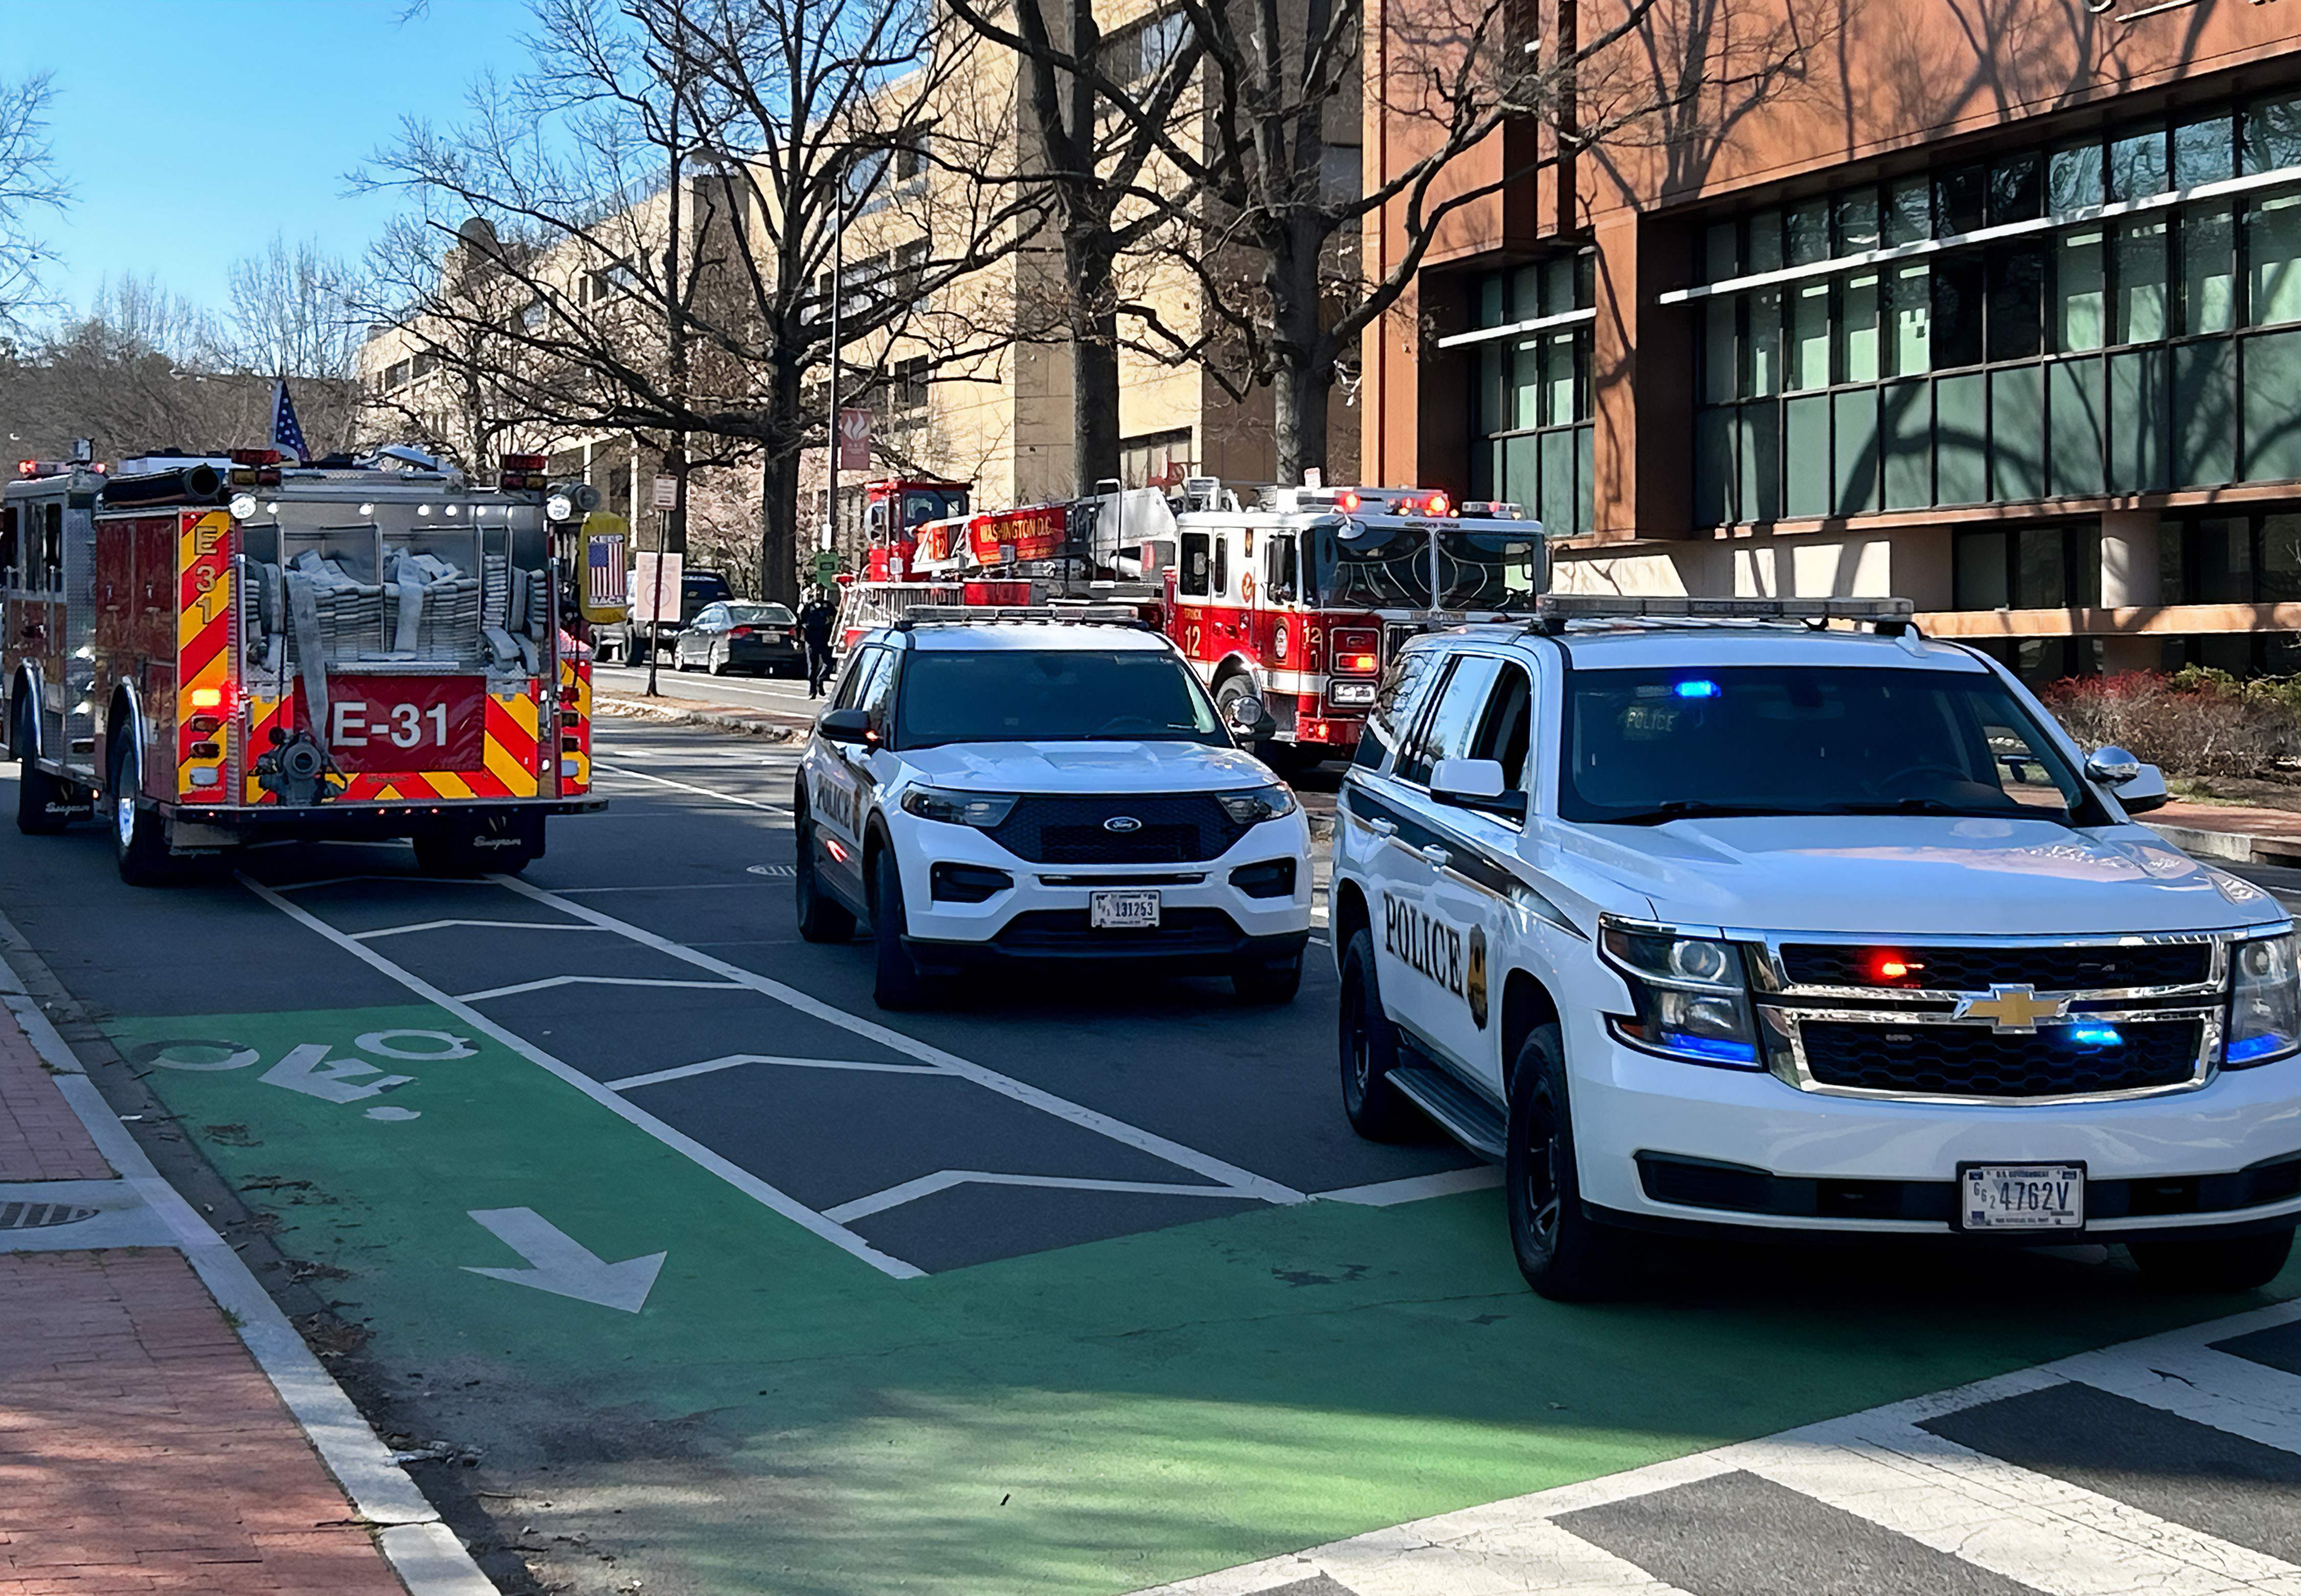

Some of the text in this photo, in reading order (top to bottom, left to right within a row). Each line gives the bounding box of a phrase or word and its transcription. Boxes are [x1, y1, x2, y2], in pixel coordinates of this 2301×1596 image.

[589, 535, 624, 543] KEEP
[589, 596, 624, 605] BACK
[1185, 625, 1201, 657] 12
[1303, 626, 1322, 644] 12
[332, 702, 446, 748] E-31
[1626, 711, 1675, 732] POLICE
[816, 773, 851, 829] POLICE
[1383, 890, 1465, 1000] POLICE
[1999, 1181, 2069, 1211] 4762V
